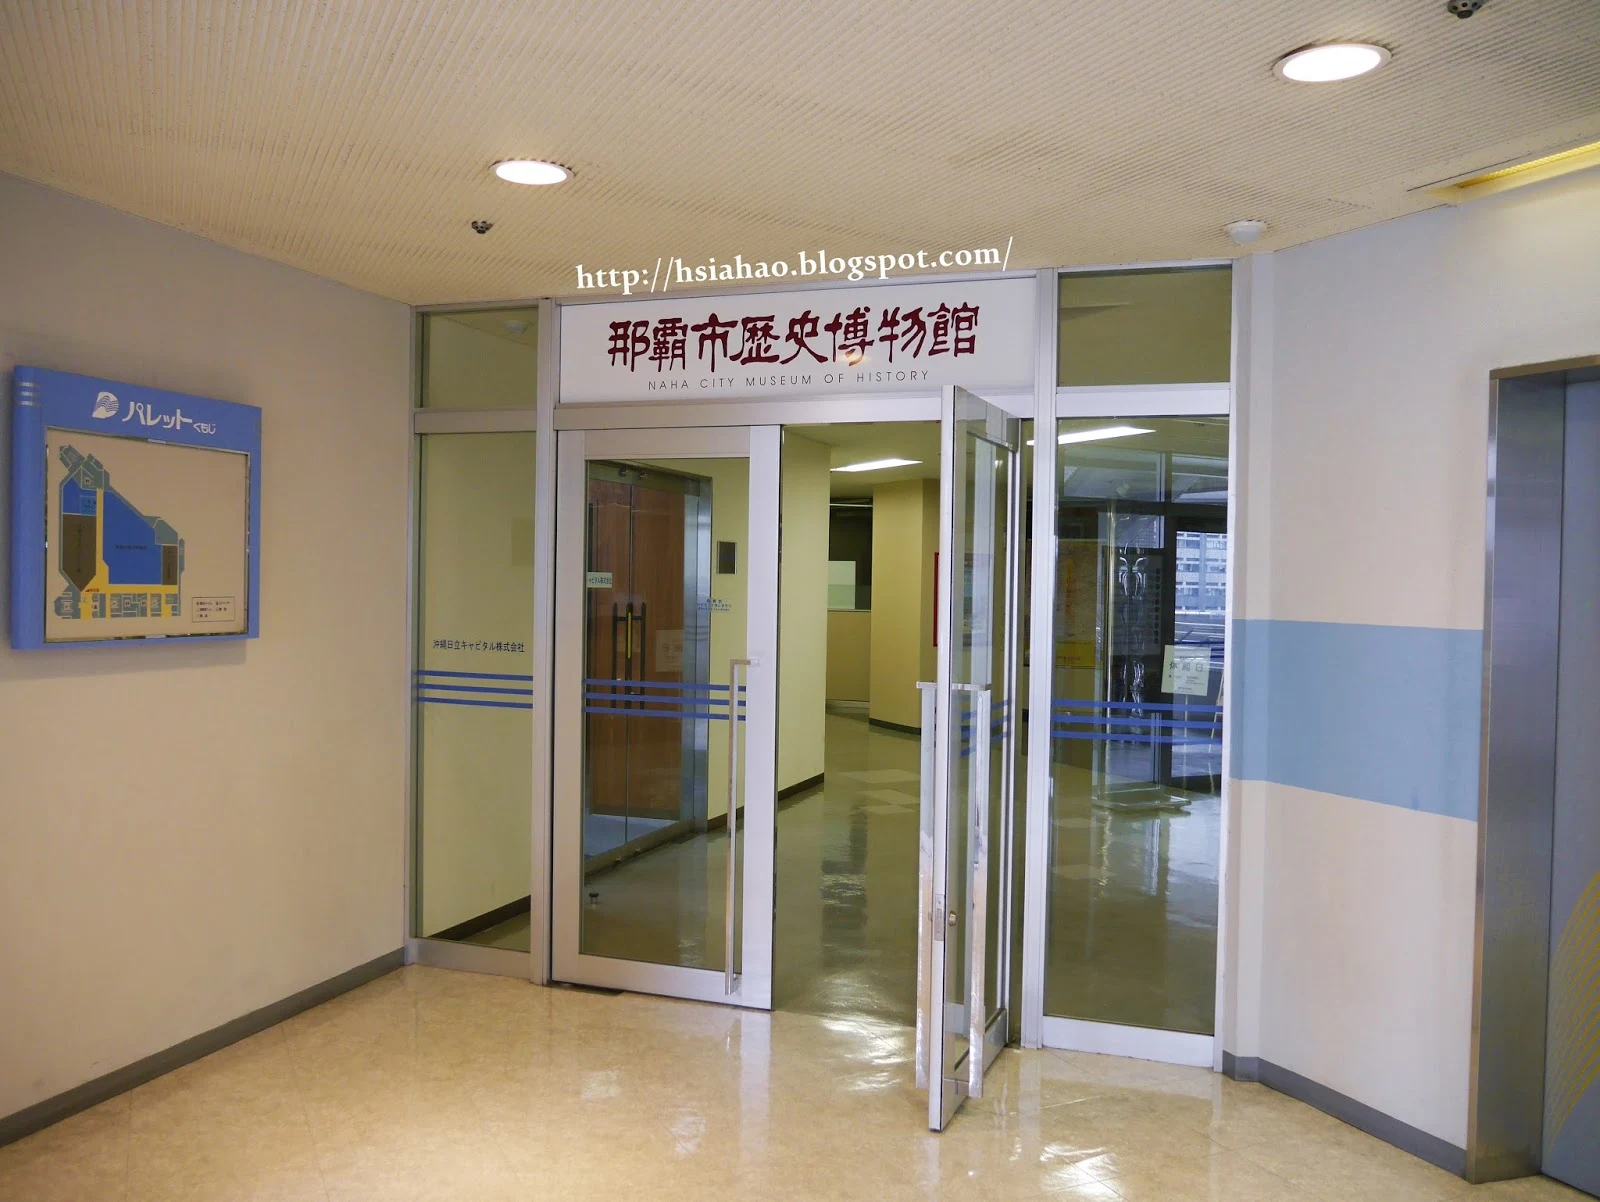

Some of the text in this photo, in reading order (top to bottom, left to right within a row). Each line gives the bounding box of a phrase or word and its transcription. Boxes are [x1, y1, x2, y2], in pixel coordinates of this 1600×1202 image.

[648, 370, 929, 391] NAHA CITY MUSEUM OF HISTORY
